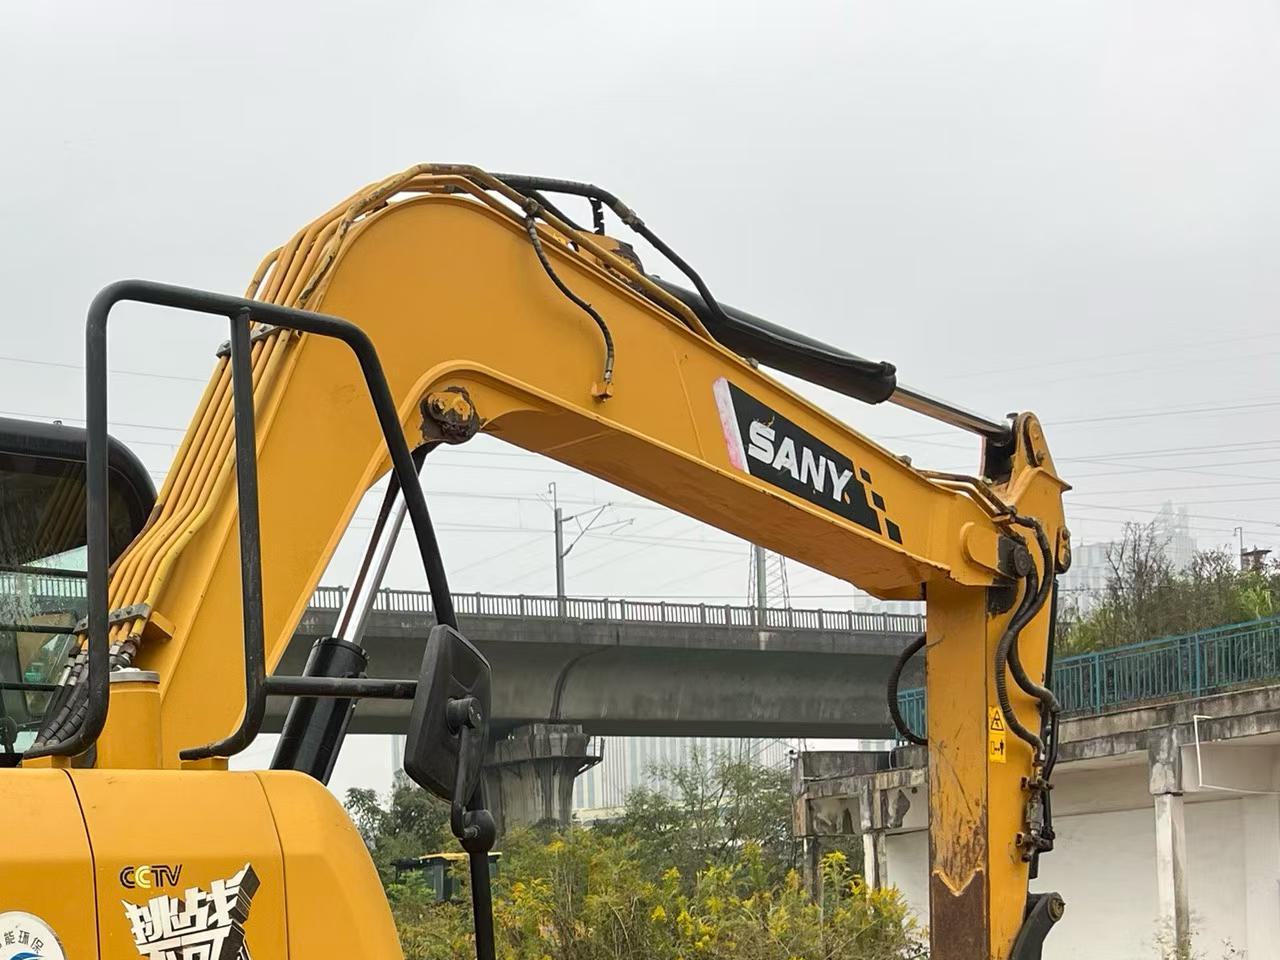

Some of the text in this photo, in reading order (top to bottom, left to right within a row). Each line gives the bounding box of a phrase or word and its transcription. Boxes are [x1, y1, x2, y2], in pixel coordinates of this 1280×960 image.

[748, 420, 853, 502] SANY
[120, 864, 182, 888] CCTV
[122, 862, 252, 945] 挑战
